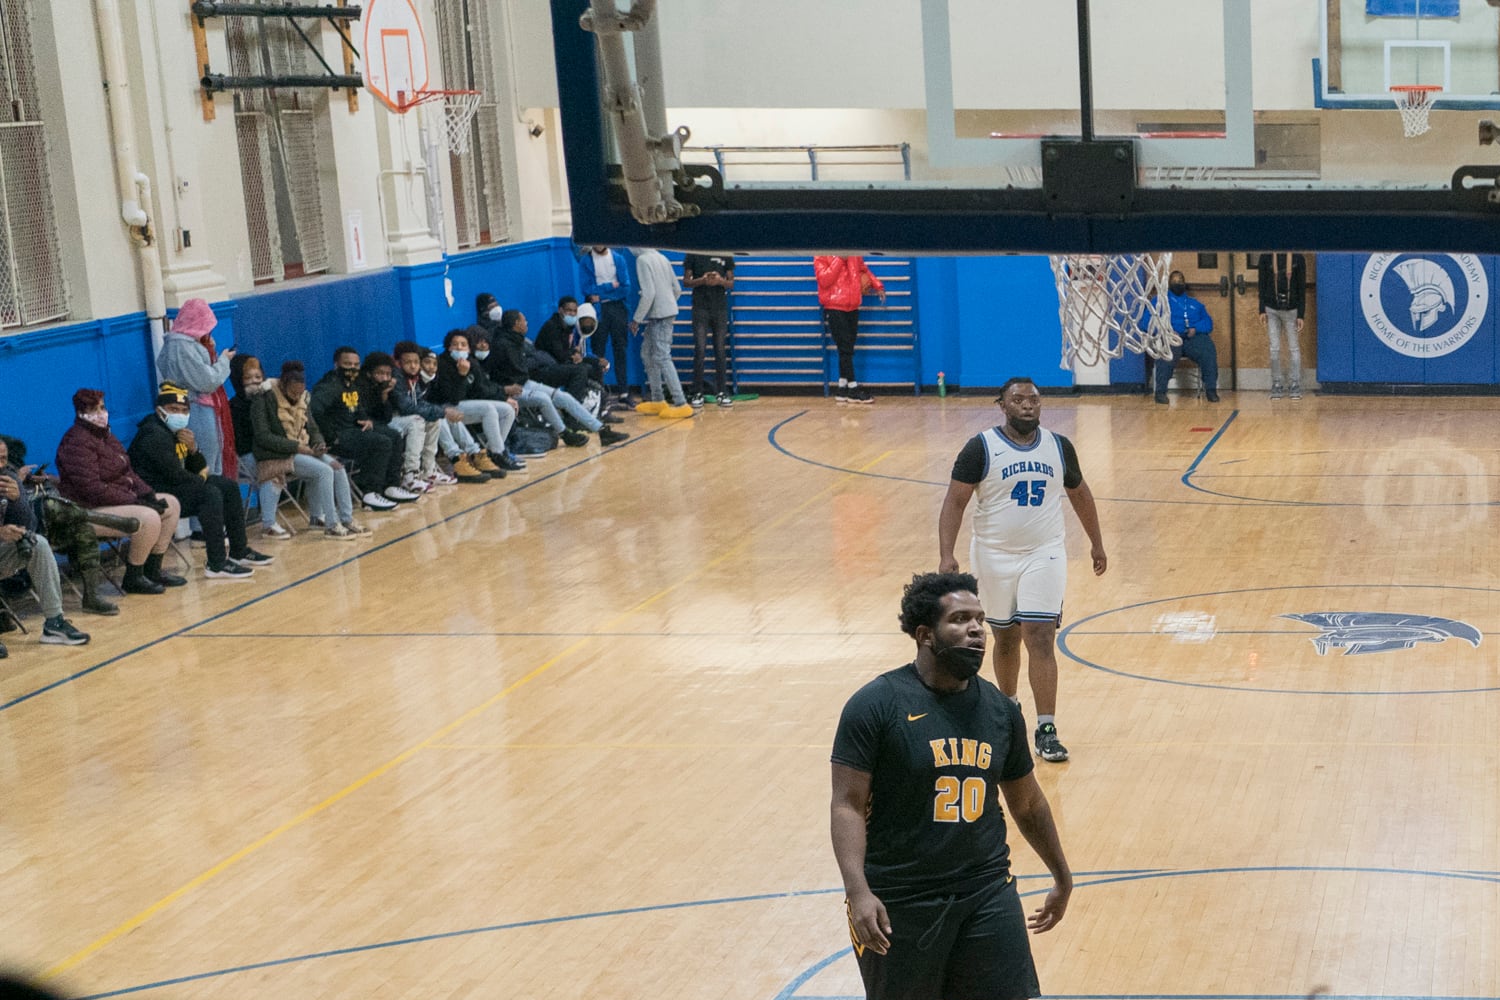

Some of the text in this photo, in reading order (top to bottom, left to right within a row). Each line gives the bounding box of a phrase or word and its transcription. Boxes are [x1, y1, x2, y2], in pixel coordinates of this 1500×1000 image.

[1371, 313, 1477, 353] HOME OF THE WARRIORS
[1001, 460, 1055, 480] RICHARDS
[1010, 480, 1047, 507] 45
[929, 738, 993, 770] KING
[933, 775, 986, 823] 20
